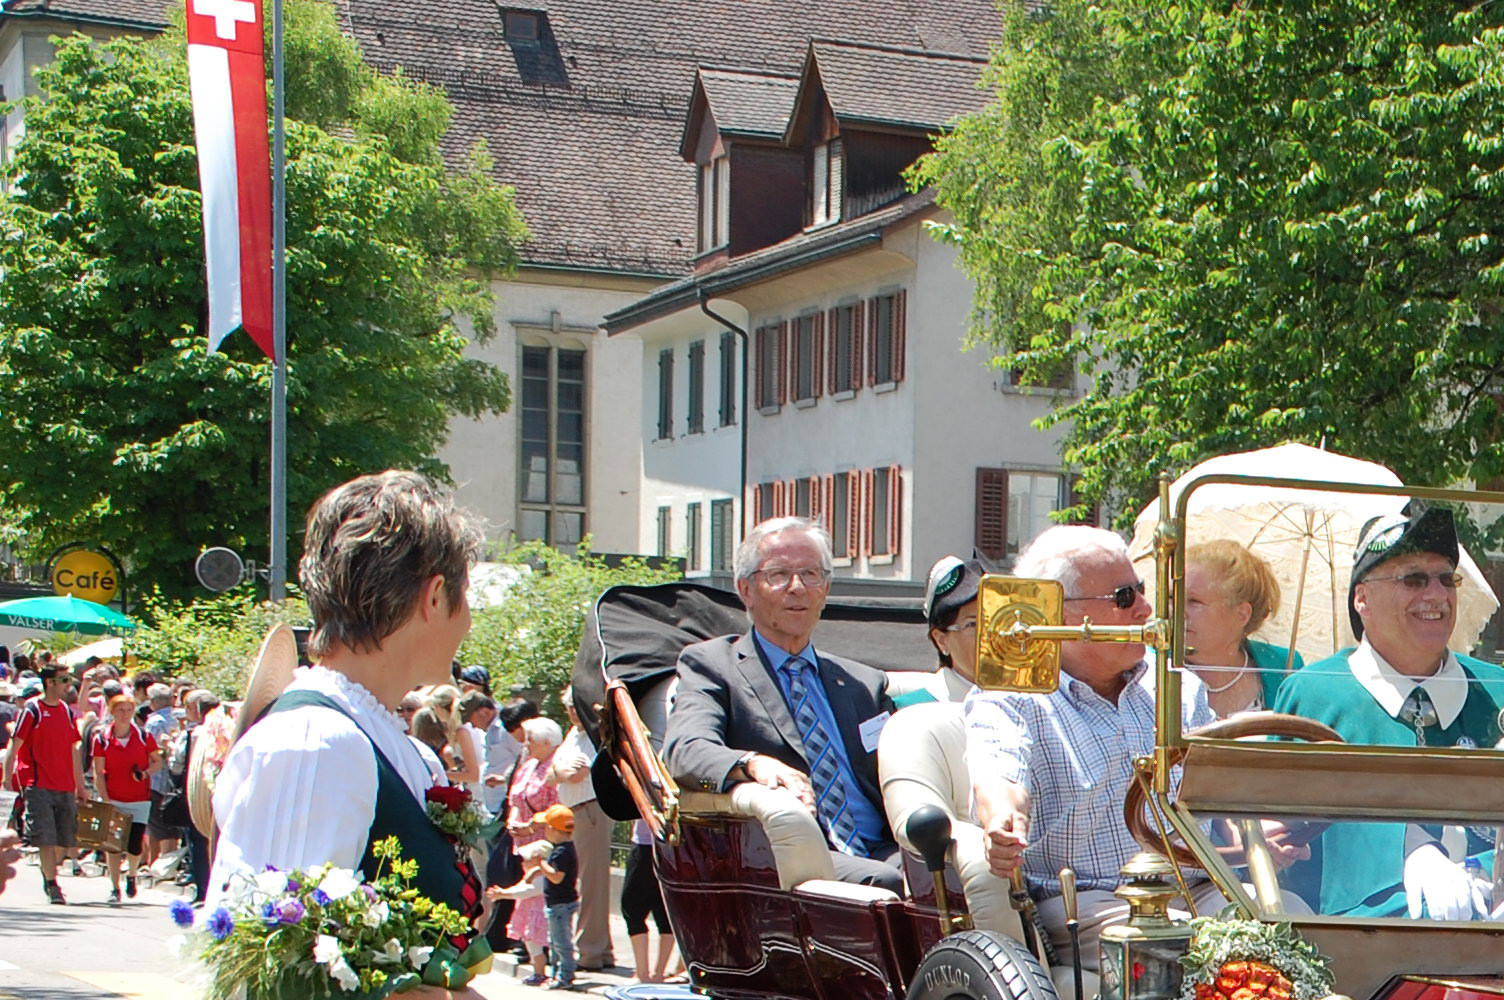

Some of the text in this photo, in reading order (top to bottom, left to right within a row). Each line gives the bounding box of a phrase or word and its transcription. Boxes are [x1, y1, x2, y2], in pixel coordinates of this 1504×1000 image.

[56, 569, 115, 590] Café
[8, 614, 55, 631] VALSER
[924, 965, 970, 992] DUNLOP
